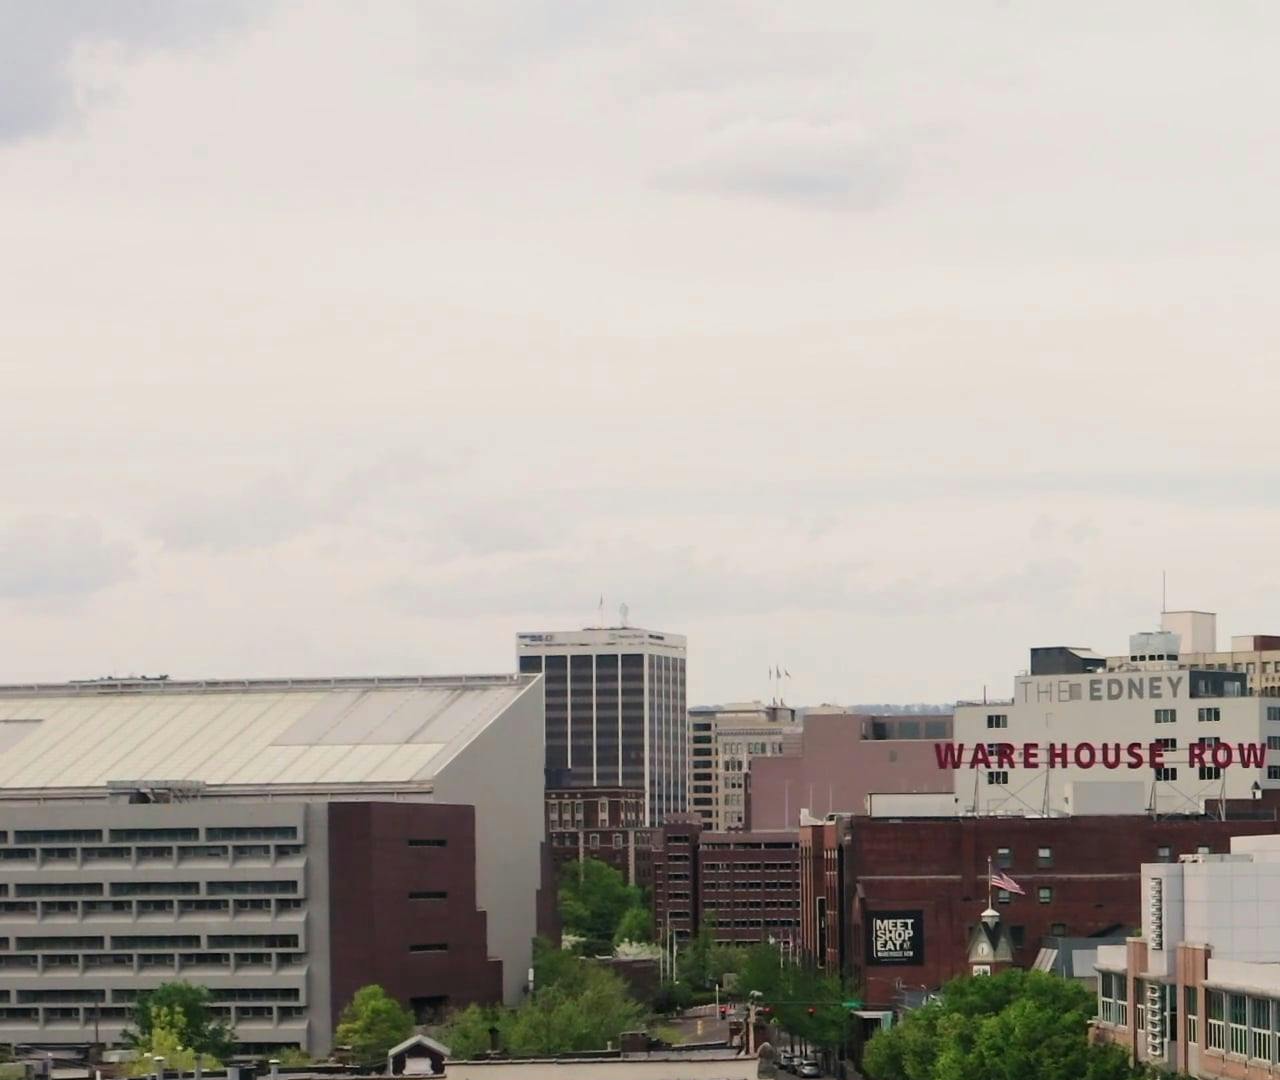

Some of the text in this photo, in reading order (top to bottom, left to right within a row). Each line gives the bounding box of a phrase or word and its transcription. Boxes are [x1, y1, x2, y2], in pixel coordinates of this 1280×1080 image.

[1020, 676, 1183, 703] THE EDNEY
[934, 742, 1267, 769] WAREHOUSE ROW
[875, 918, 914, 930] MEET
[876, 929, 914, 941] SHOP
[876, 940, 902, 951] EAT
